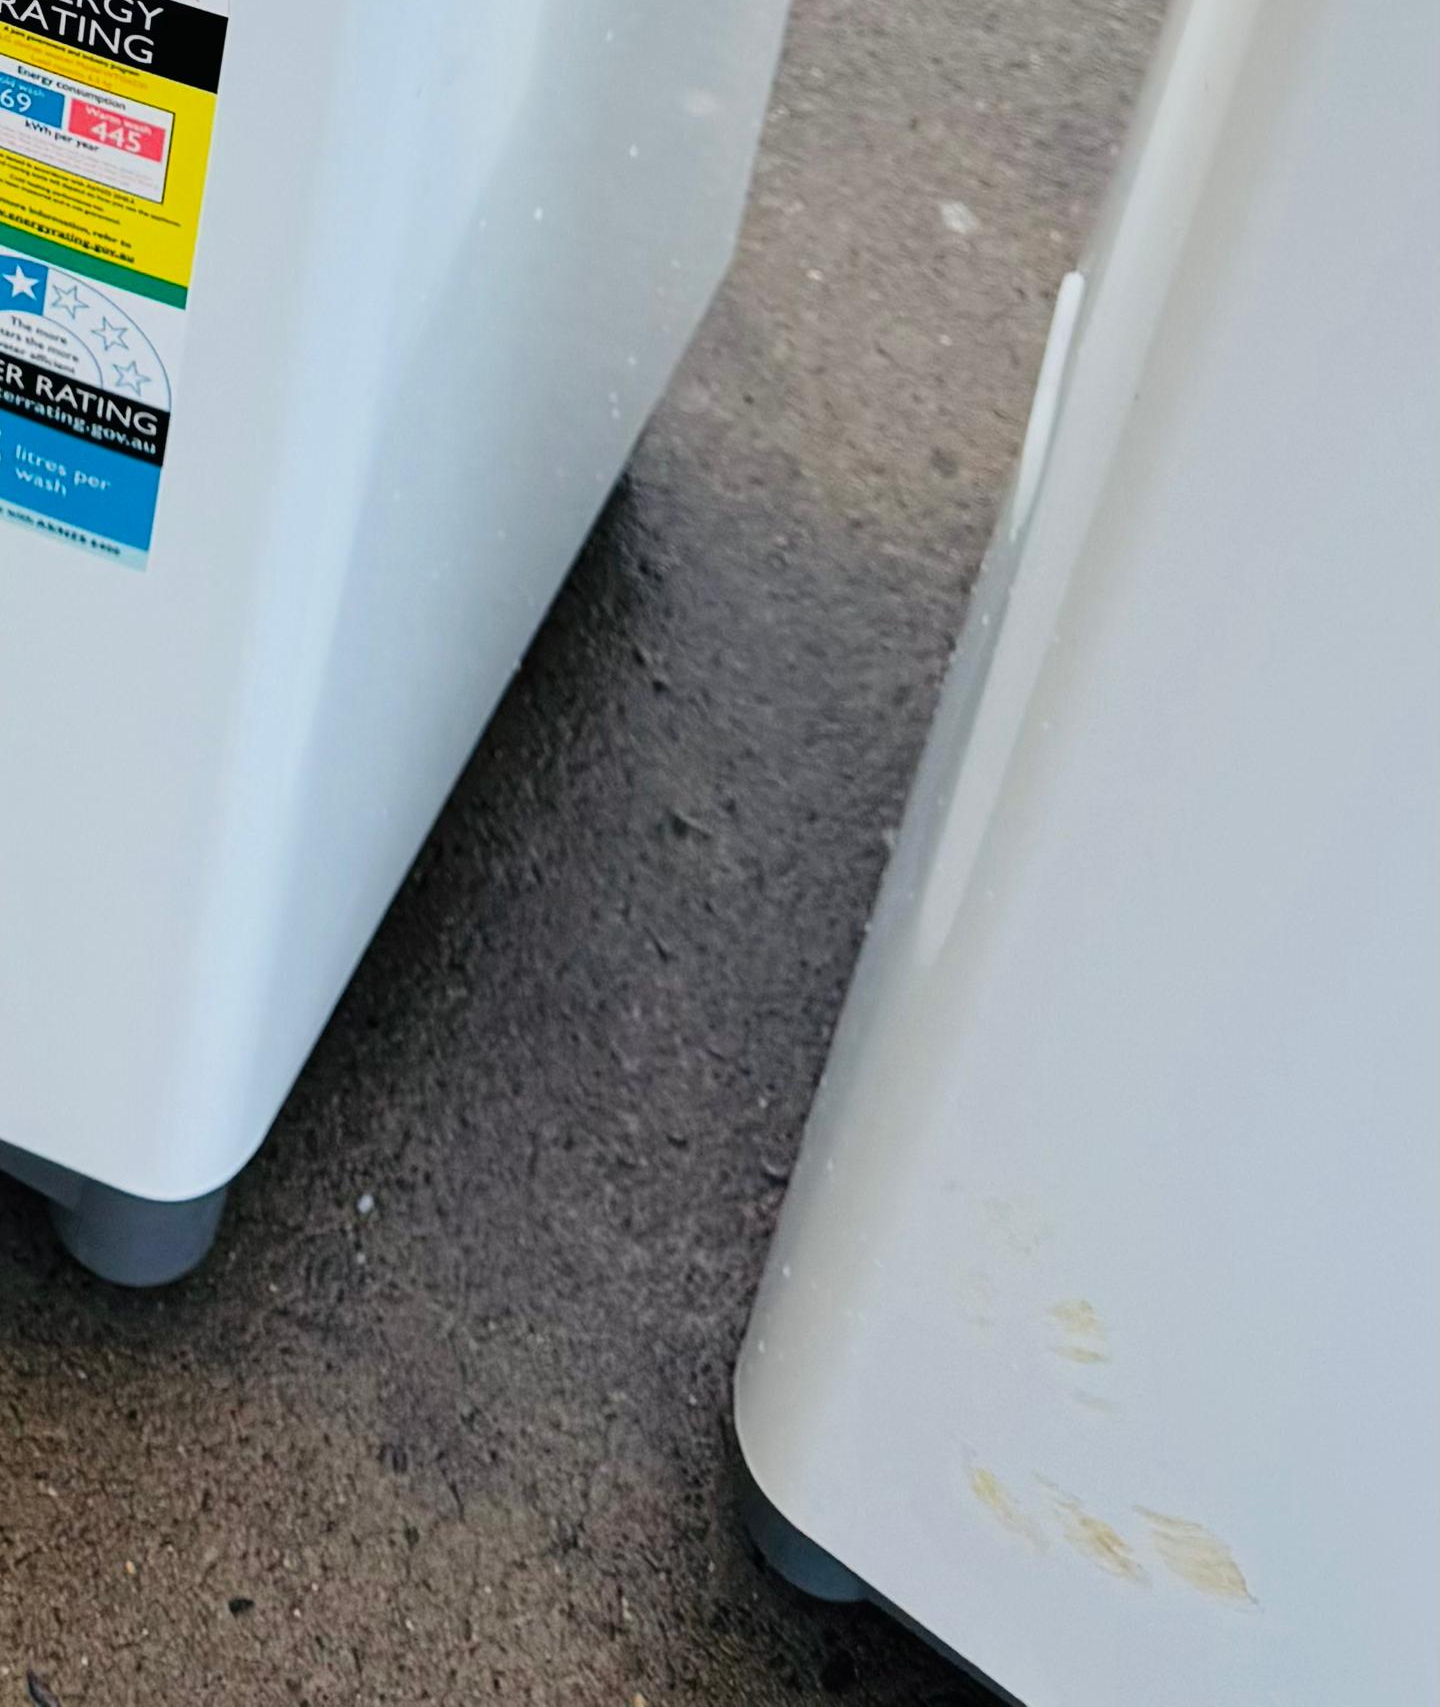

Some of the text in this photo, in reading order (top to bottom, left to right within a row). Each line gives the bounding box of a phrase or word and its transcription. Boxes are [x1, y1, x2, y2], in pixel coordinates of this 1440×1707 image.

[0, 88, 32, 113] 69
[17, 65, 52, 86] Energy
[56, 80, 127, 111] consumption
[85, 105, 153, 135] Warm wash
[54, 131, 74, 144] per
[76, 137, 100, 152] year
[90, 122, 142, 154] 445
[11, 315, 68, 345] The more
[25, 335, 45, 350] the
[47, 346, 80, 363] more
[36, 374, 158, 436] RATING
[15, 444, 67, 477] litres
[74, 469, 111, 491] per
[15, 467, 68, 498] wash
